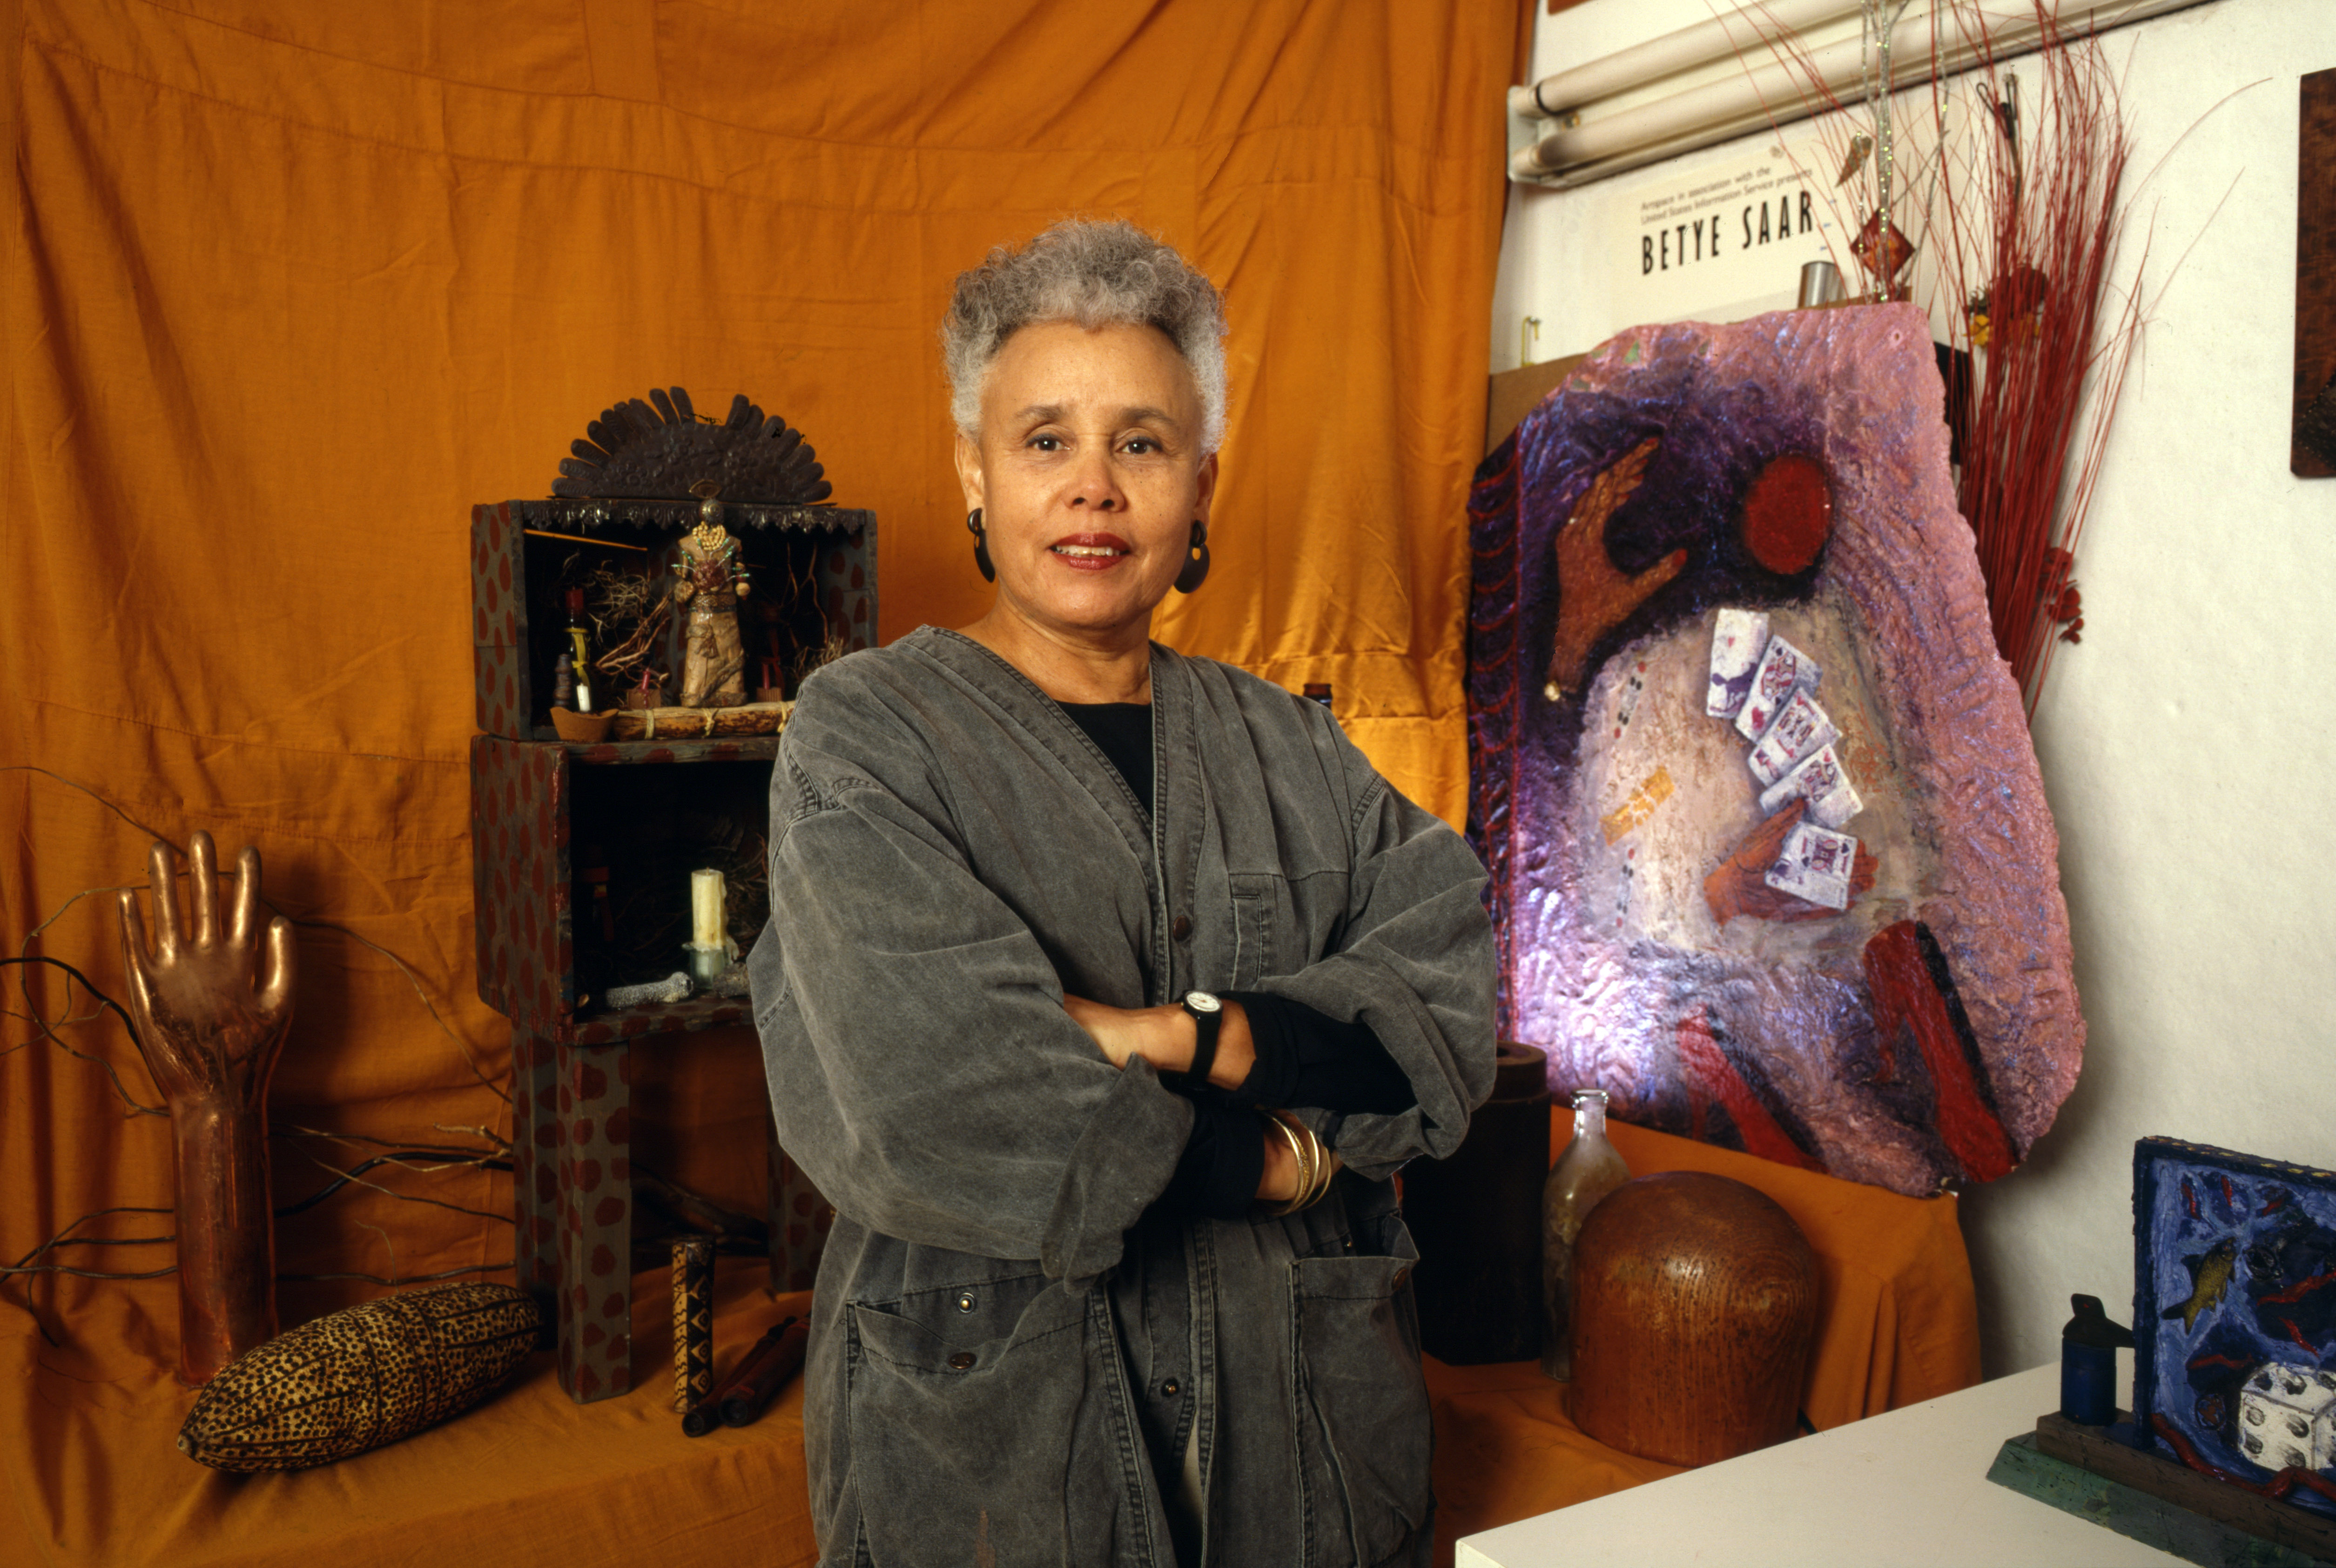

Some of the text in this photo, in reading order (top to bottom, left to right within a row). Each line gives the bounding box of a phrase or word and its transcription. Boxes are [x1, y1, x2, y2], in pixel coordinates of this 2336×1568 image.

[1734, 171, 1753, 183] with
[1756, 167, 1771, 177] the
[1695, 190, 1741, 209] Information
[1744, 180, 1773, 195] Service
[1642, 190, 1812, 276] BETYE SAAR
